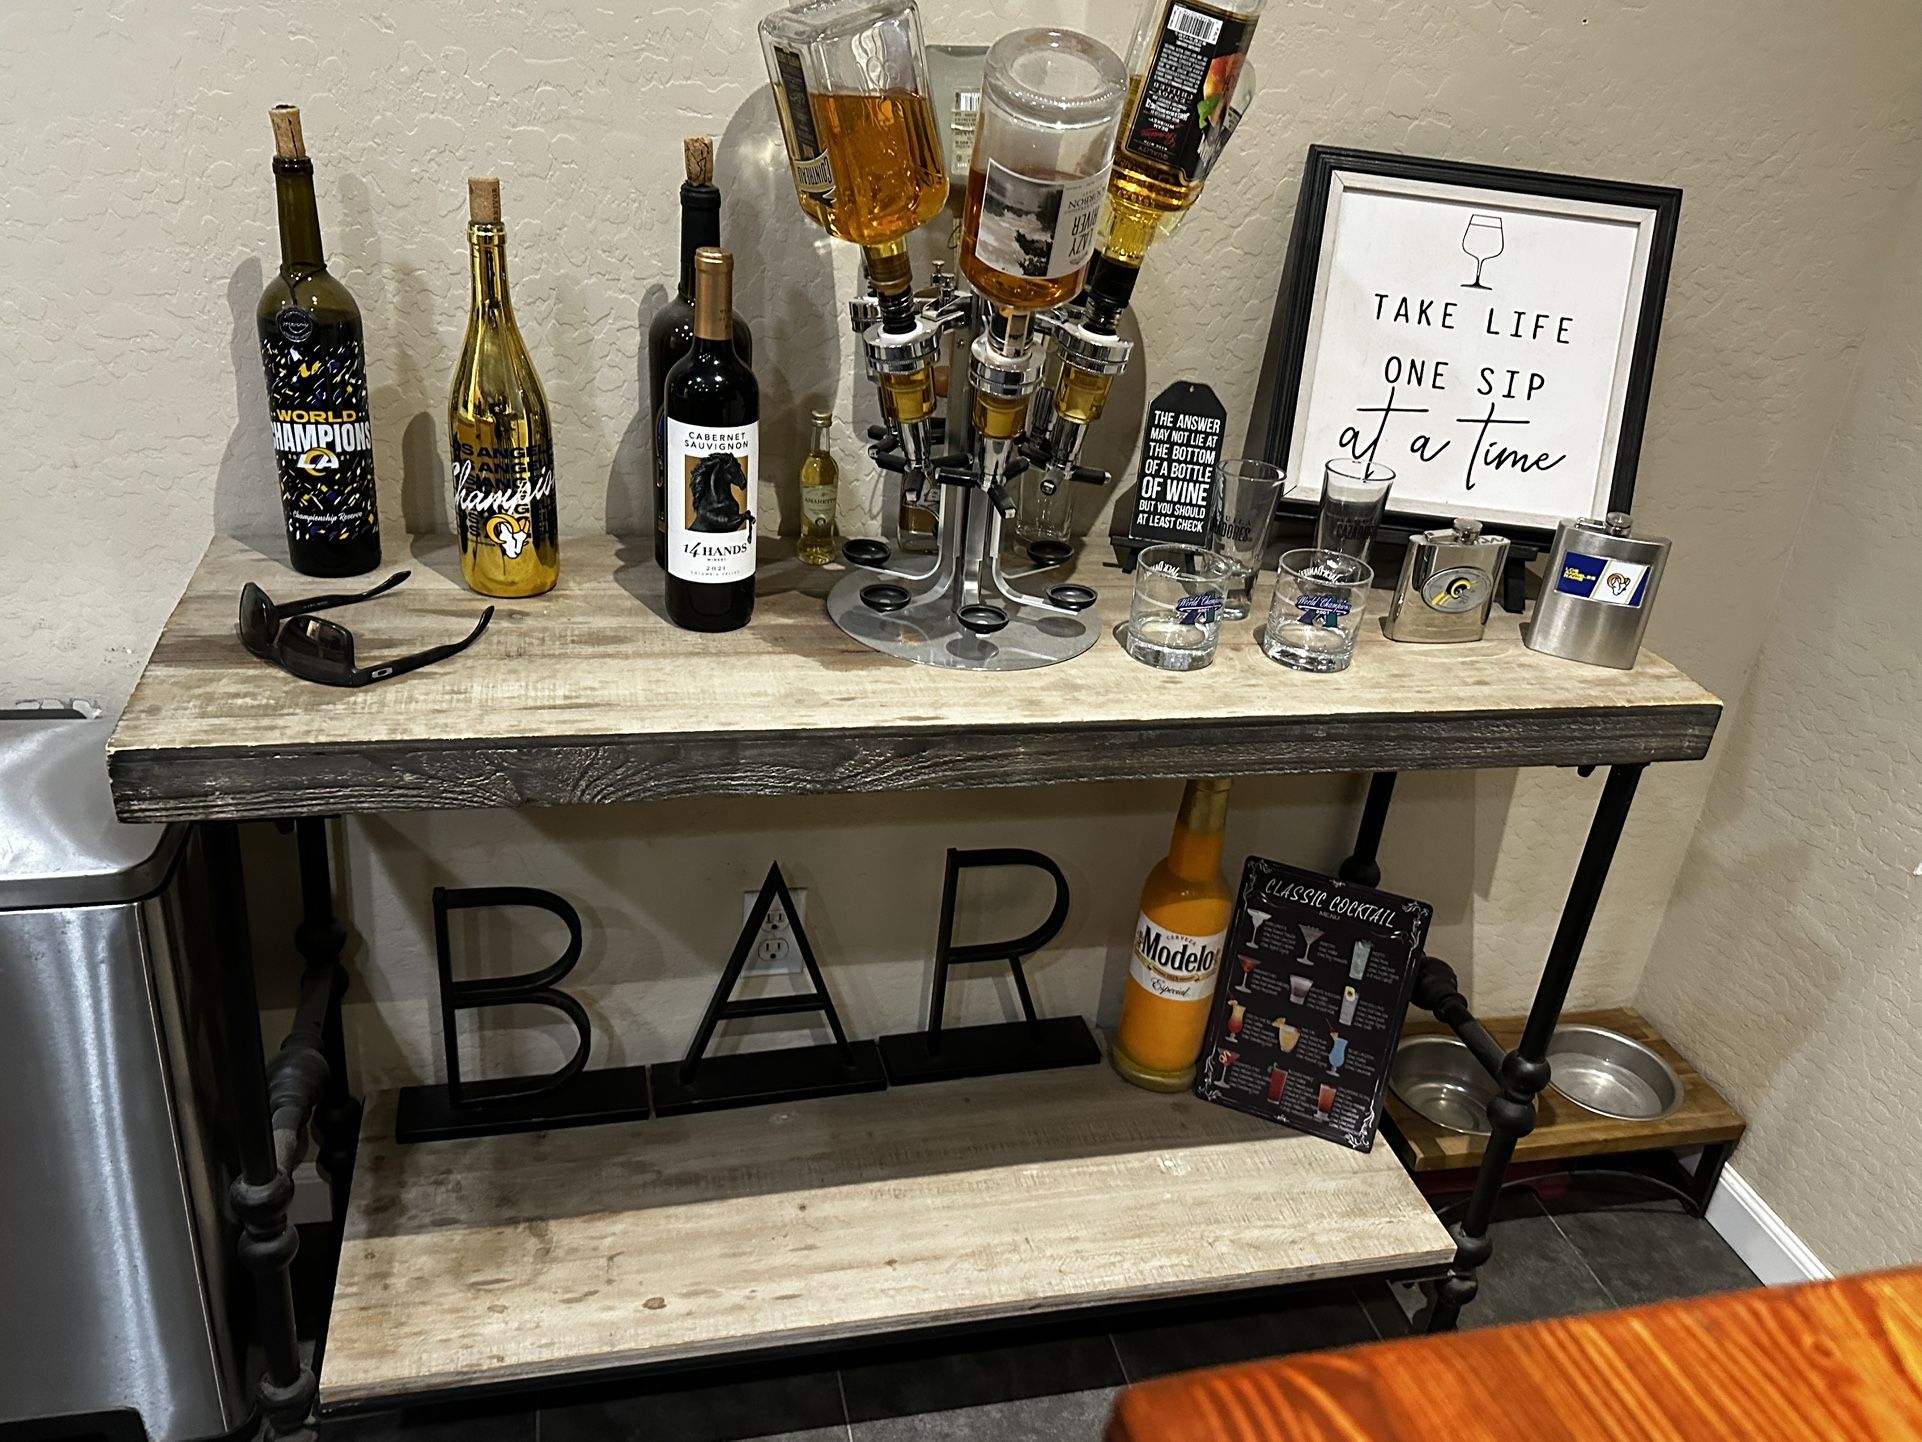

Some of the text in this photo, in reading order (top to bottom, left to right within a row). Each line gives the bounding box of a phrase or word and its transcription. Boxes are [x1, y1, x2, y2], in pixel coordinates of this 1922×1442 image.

[1153, 82, 1193, 100] CHILLED
[1158, 90, 1186, 103] ENJOY
[1138, 146, 1169, 160] QUALITY
[1071, 205, 1099, 236] RIVER
[1068, 228, 1094, 257] LAZY
[1373, 293, 1574, 344] TAKE LIFE
[1384, 356, 1546, 401] ONE SIP
[276, 409, 357, 423] WORLD
[1154, 410, 1221, 434] THE ANSWER
[270, 421, 372, 453] HAMPIONS
[684, 439, 749, 451] SAUVIGNON
[688, 431, 746, 441] CABERNET
[1150, 427, 1218, 448] MAY NOT LIE AT
[1338, 386, 1567, 491] at a time
[1149, 441, 1216, 465] THE BOTTOM
[1144, 458, 1213, 482] OF A BOTTLE
[1141, 476, 1210, 506] OF WINE
[292, 510, 363, 525] Championship Reserve
[1138, 499, 1206, 519] BUT YOU SHOULD
[1136, 513, 1204, 533] AT LEAST CHECK
[684, 542, 748, 558] 14 HANDS
[1178, 596, 1200, 608] World
[1298, 596, 1321, 607] World
[1265, 878, 1396, 928] CLASSIC COCKTAIL
[1319, 910, 1340, 920] MENU
[1141, 925, 1215, 973] Modelo
[1166, 935, 1197, 946] CERVEZA
[432, 848, 1070, 1107] BAR
[1150, 977, 1191, 997] Especial
